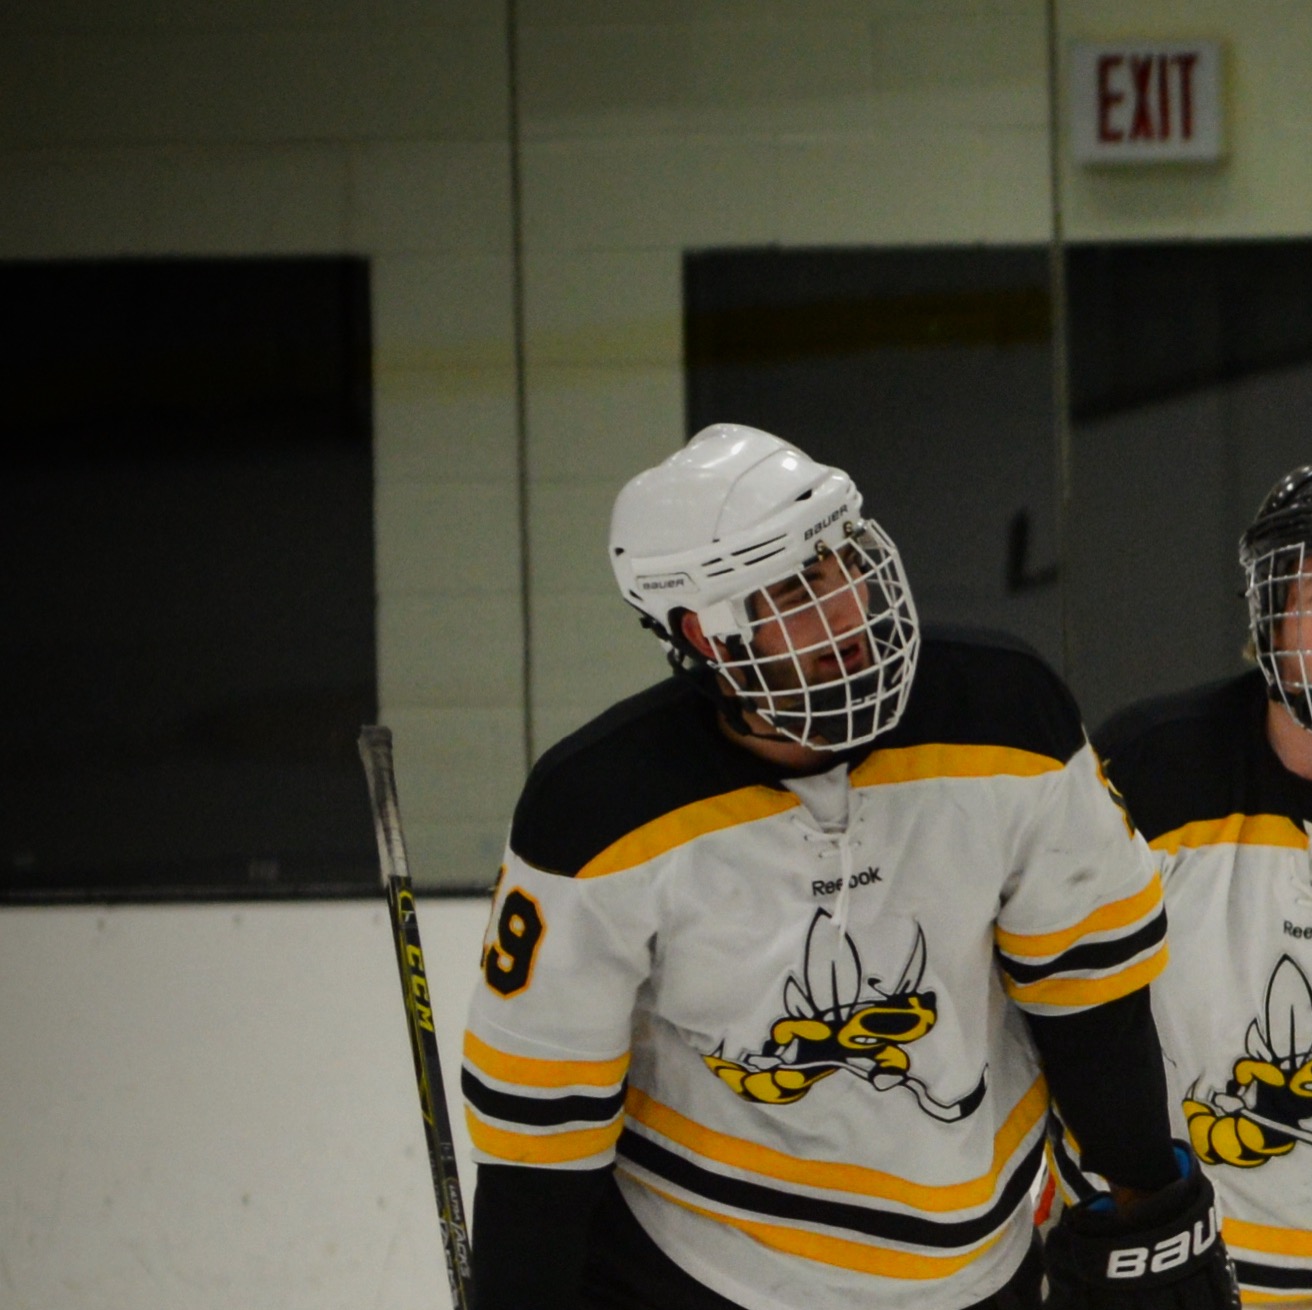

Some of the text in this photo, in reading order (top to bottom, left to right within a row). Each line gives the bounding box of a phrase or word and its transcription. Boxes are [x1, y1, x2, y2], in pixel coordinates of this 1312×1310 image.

[1097, 53, 1199, 142] EXIT
[803, 503, 849, 542] BAUER
[642, 575, 685, 591] BAUER
[482, 863, 547, 1000] 9
[405, 943, 435, 1034] CCM
